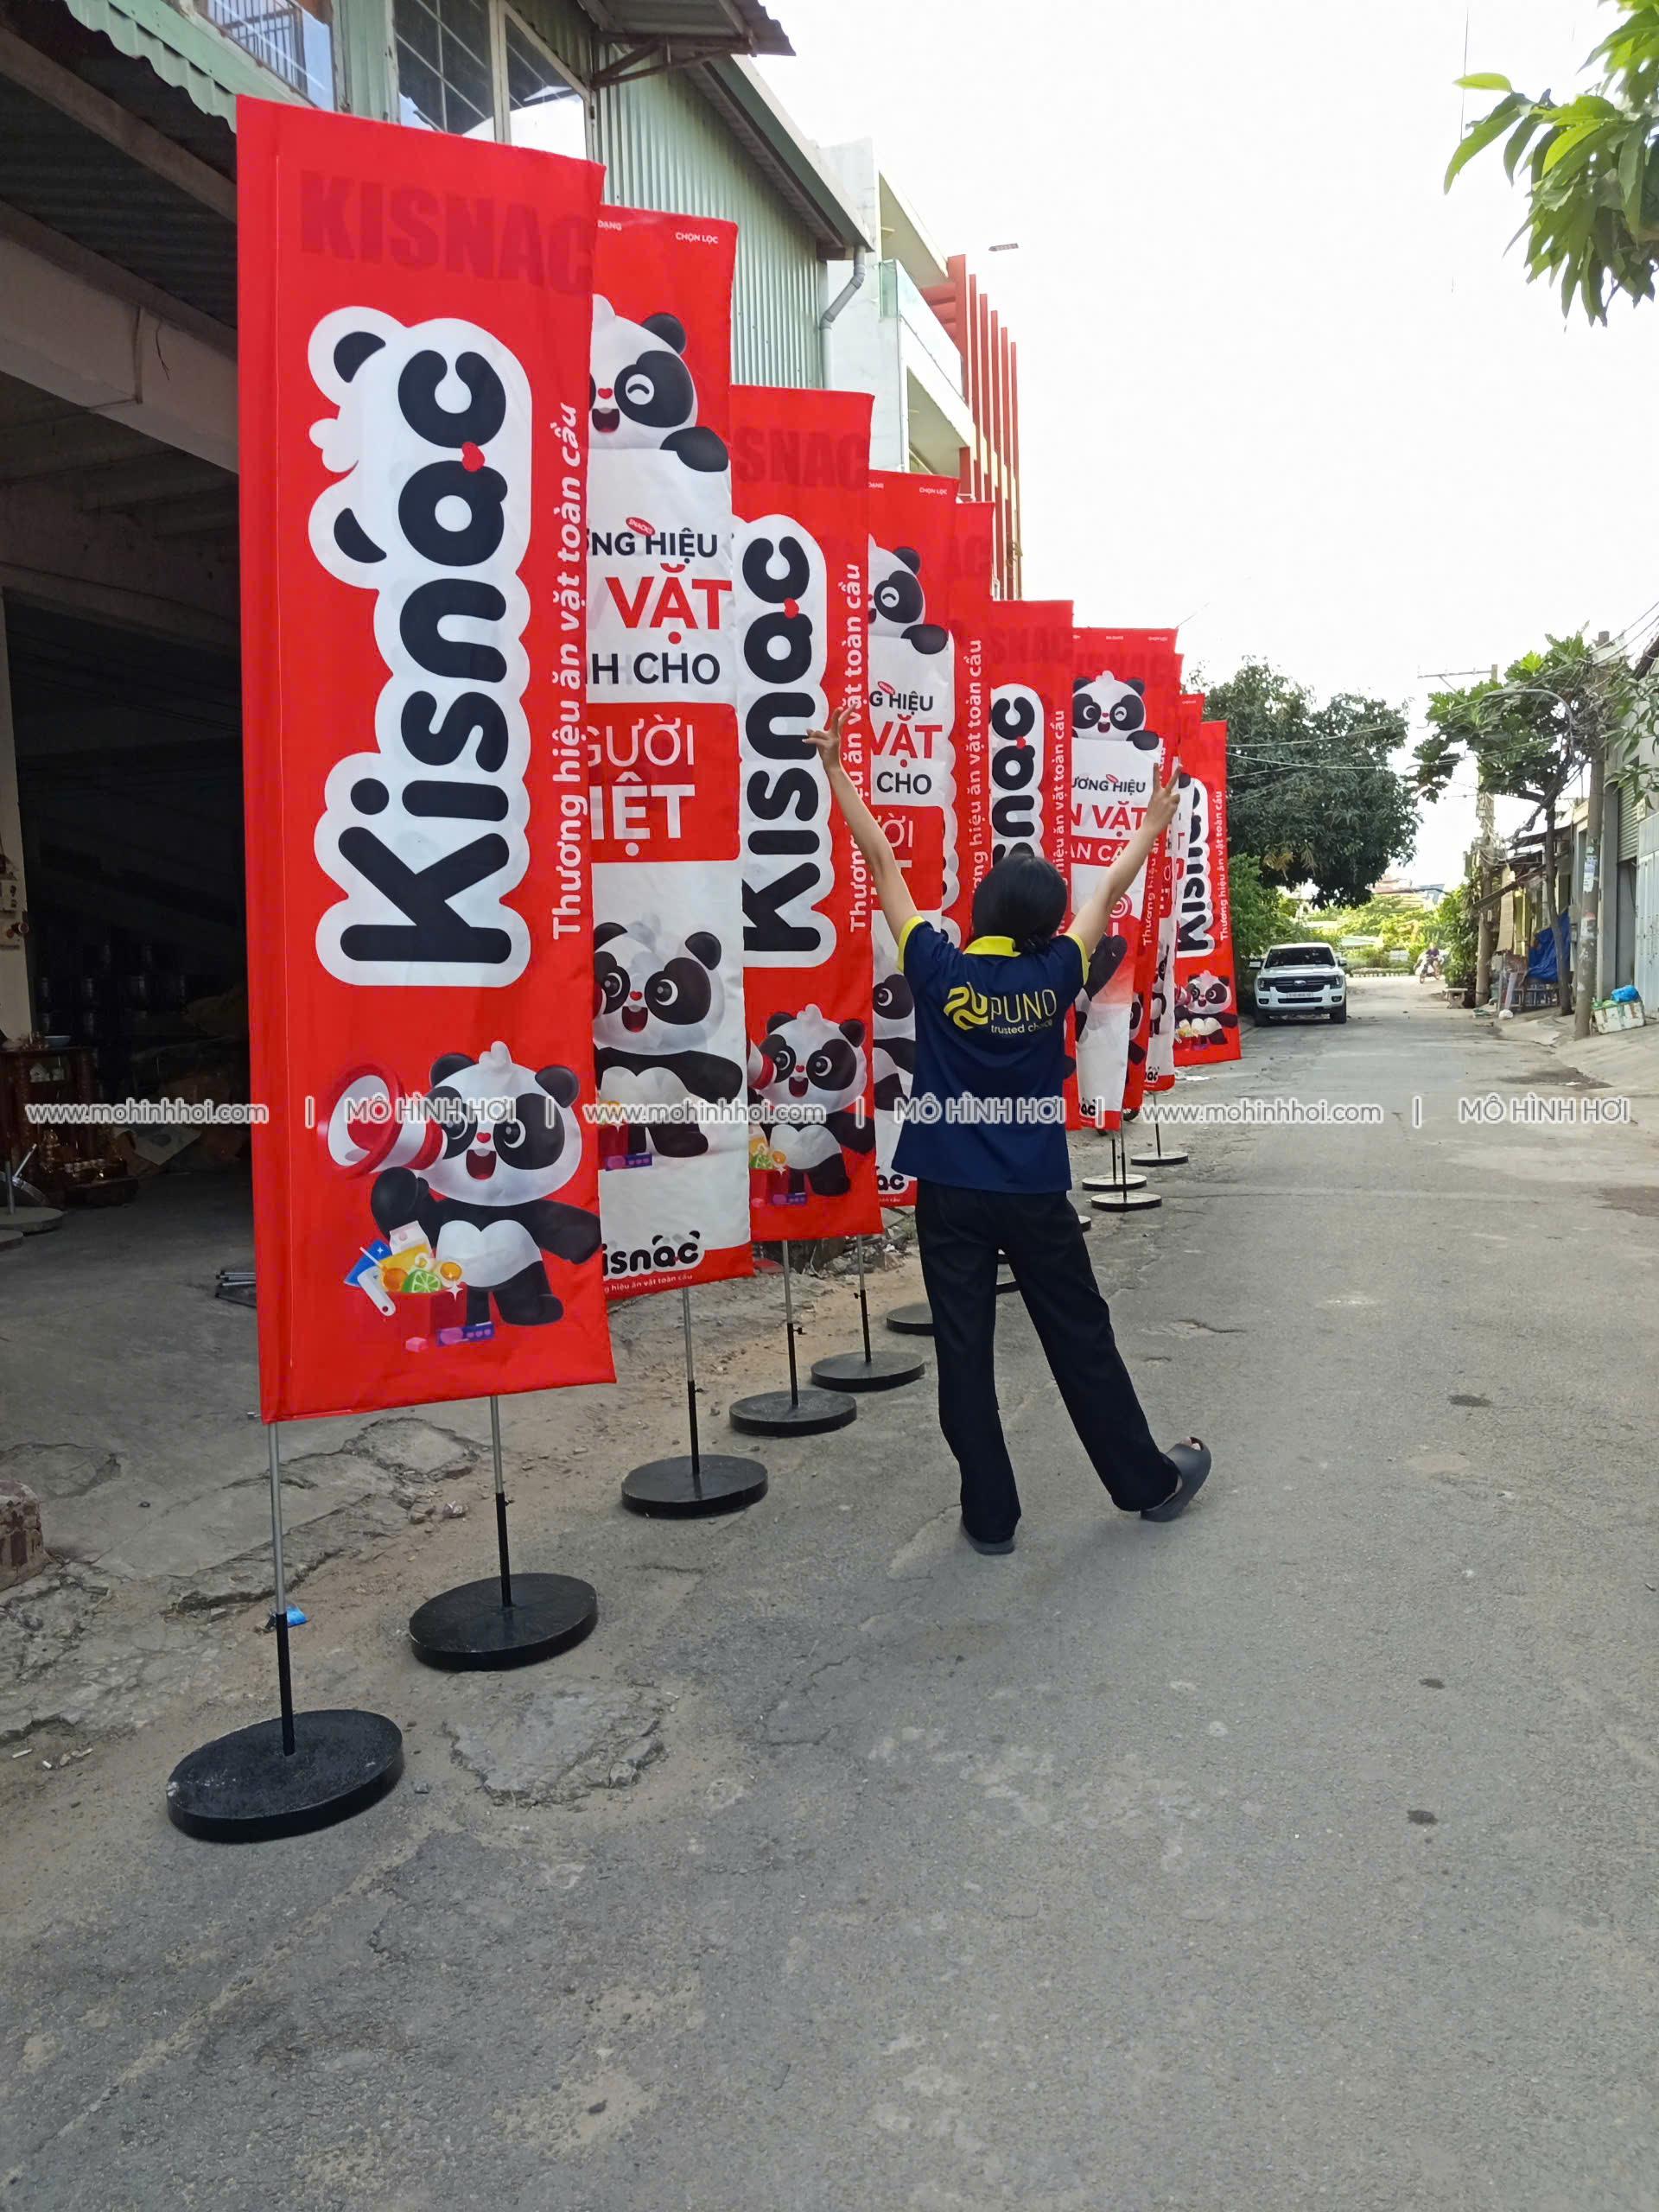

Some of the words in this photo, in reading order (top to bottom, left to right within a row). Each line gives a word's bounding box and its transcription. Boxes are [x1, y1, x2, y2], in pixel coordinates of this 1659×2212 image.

[300, 168, 593, 295] KISNAC
[675, 232, 700, 243] CHỌN
[702, 235, 719, 245] LỌC
[550, 403, 581, 467] cầu
[554, 477, 581, 563] toàn
[588, 529, 635, 556] NG
[645, 528, 717, 563] HIỆU
[553, 572, 585, 631] vặt
[605, 563, 732, 644] VẶT
[838, 564, 861, 609] cầu
[339, 350, 512, 962] Kisnac
[552, 642, 580, 690] ăn
[842, 615, 861, 677] toàn
[963, 640, 982, 676] cầu
[591, 653, 619, 684] H
[633, 652, 721, 684] CHO
[889, 691, 933, 715] HIỆU
[966, 681, 982, 728] toàn
[552, 700, 586, 782] hiệu
[842, 733, 863, 763] ăn
[869, 713, 943, 767] VẶT
[966, 732, 984, 765] vặt
[877, 772, 931, 795] CHO
[967, 770, 982, 796] ăn
[1052, 744, 1065, 782] toàn
[1113, 779, 1146, 796] HIỆU
[880, 813, 913, 848] ỜI
[969, 800, 986, 846] hiệu
[1092, 801, 1147, 836] VẶT
[551, 794, 588, 940] Thương
[991, 1024, 1025, 1034] trusted
